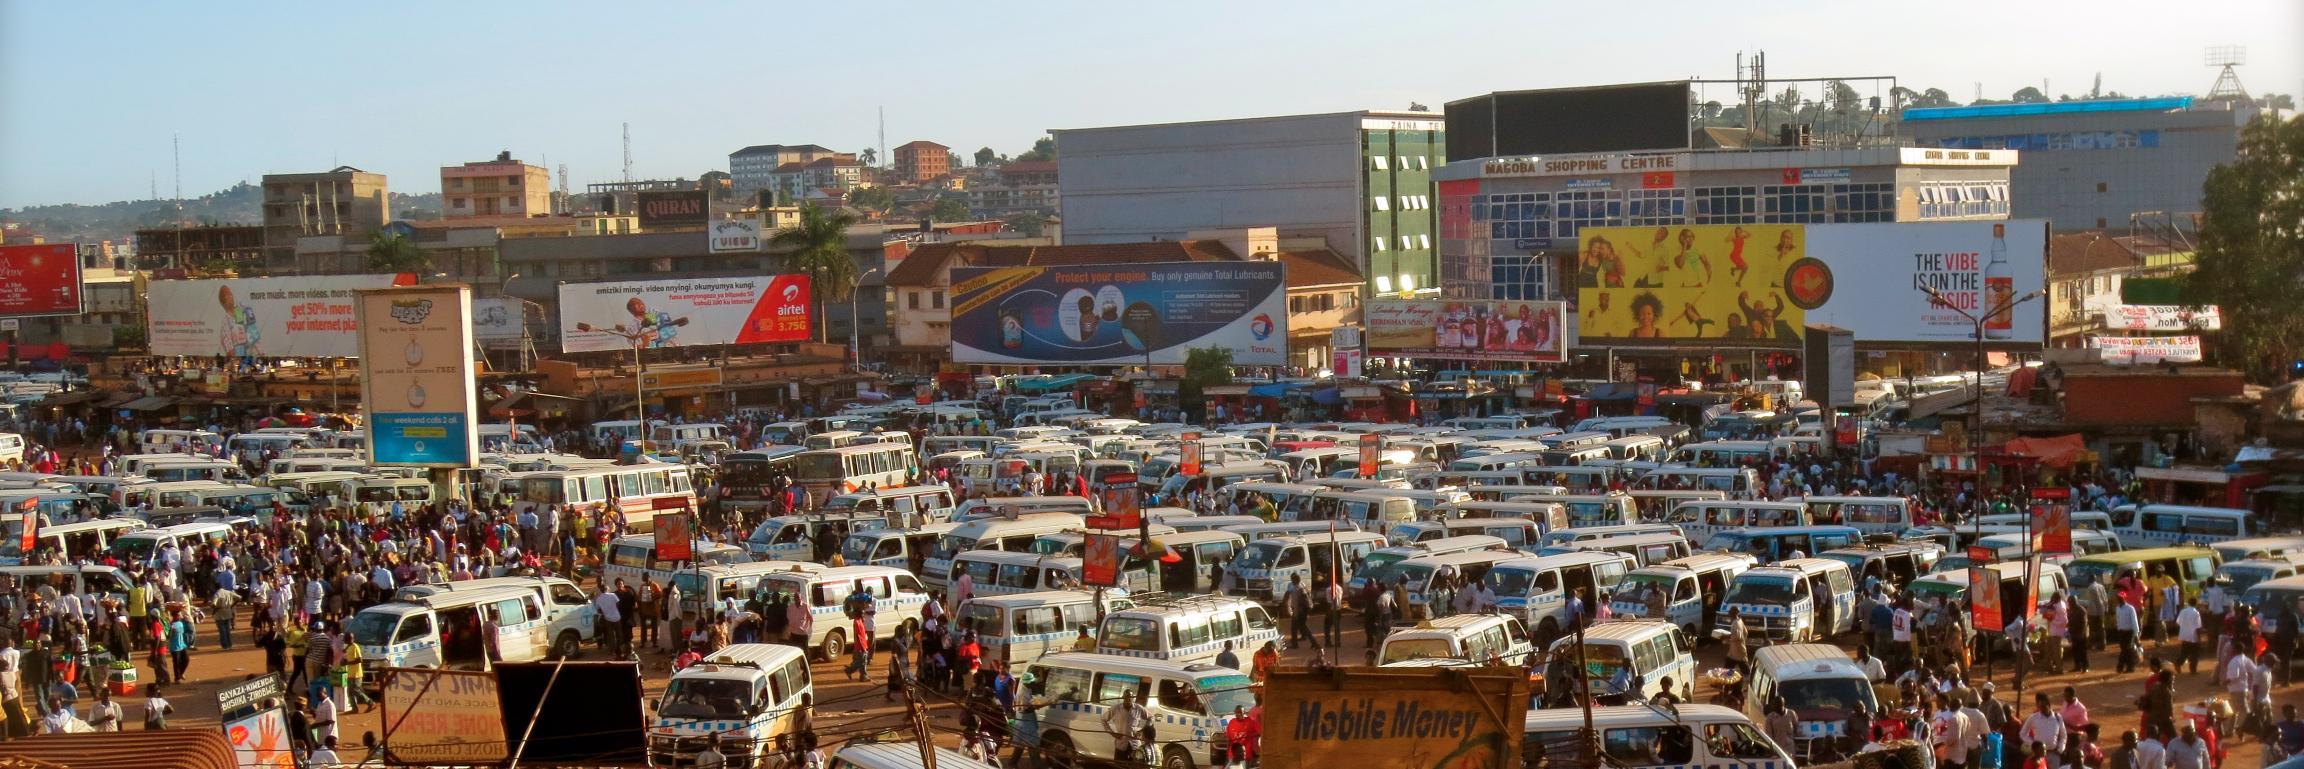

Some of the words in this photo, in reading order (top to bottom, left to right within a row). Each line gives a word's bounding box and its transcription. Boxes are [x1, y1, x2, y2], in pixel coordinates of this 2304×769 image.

[1391, 122, 1416, 130] ZAINA
[1485, 161, 1536, 174] MAGOBA
[1545, 159, 1607, 172] SHOPPING
[1621, 156, 1674, 170] CENTRE
[646, 200, 700, 217] QURAN
[716, 222, 752, 234] Pioneer
[720, 236, 750, 247] VIEW
[1915, 253, 1942, 271] THE
[1945, 253, 1979, 270] VIBE
[957, 276, 988, 293] Caution
[1055, 272, 1088, 283] Protect
[1091, 273, 1111, 285] your
[1115, 271, 1149, 284] engine.
[1151, 272, 1165, 283] Buy
[1166, 271, 1182, 282] only
[1184, 271, 1213, 282] genuine
[1214, 270, 1232, 280] Total
[1914, 273, 1927, 290] IS
[1930, 273, 1948, 290] ON
[1951, 273, 1978, 290] THE
[330, 290, 348, 298] more
[1931, 292, 1978, 310] INSIDE
[291, 304, 305, 319] get
[306, 302, 328, 315] 50%
[329, 304, 352, 314] more
[778, 304, 805, 316] airtel
[286, 321, 304, 335] your
[306, 317, 341, 330] internet
[1294, 698, 1386, 741] Mobile
[1390, 700, 1480, 739] Money
